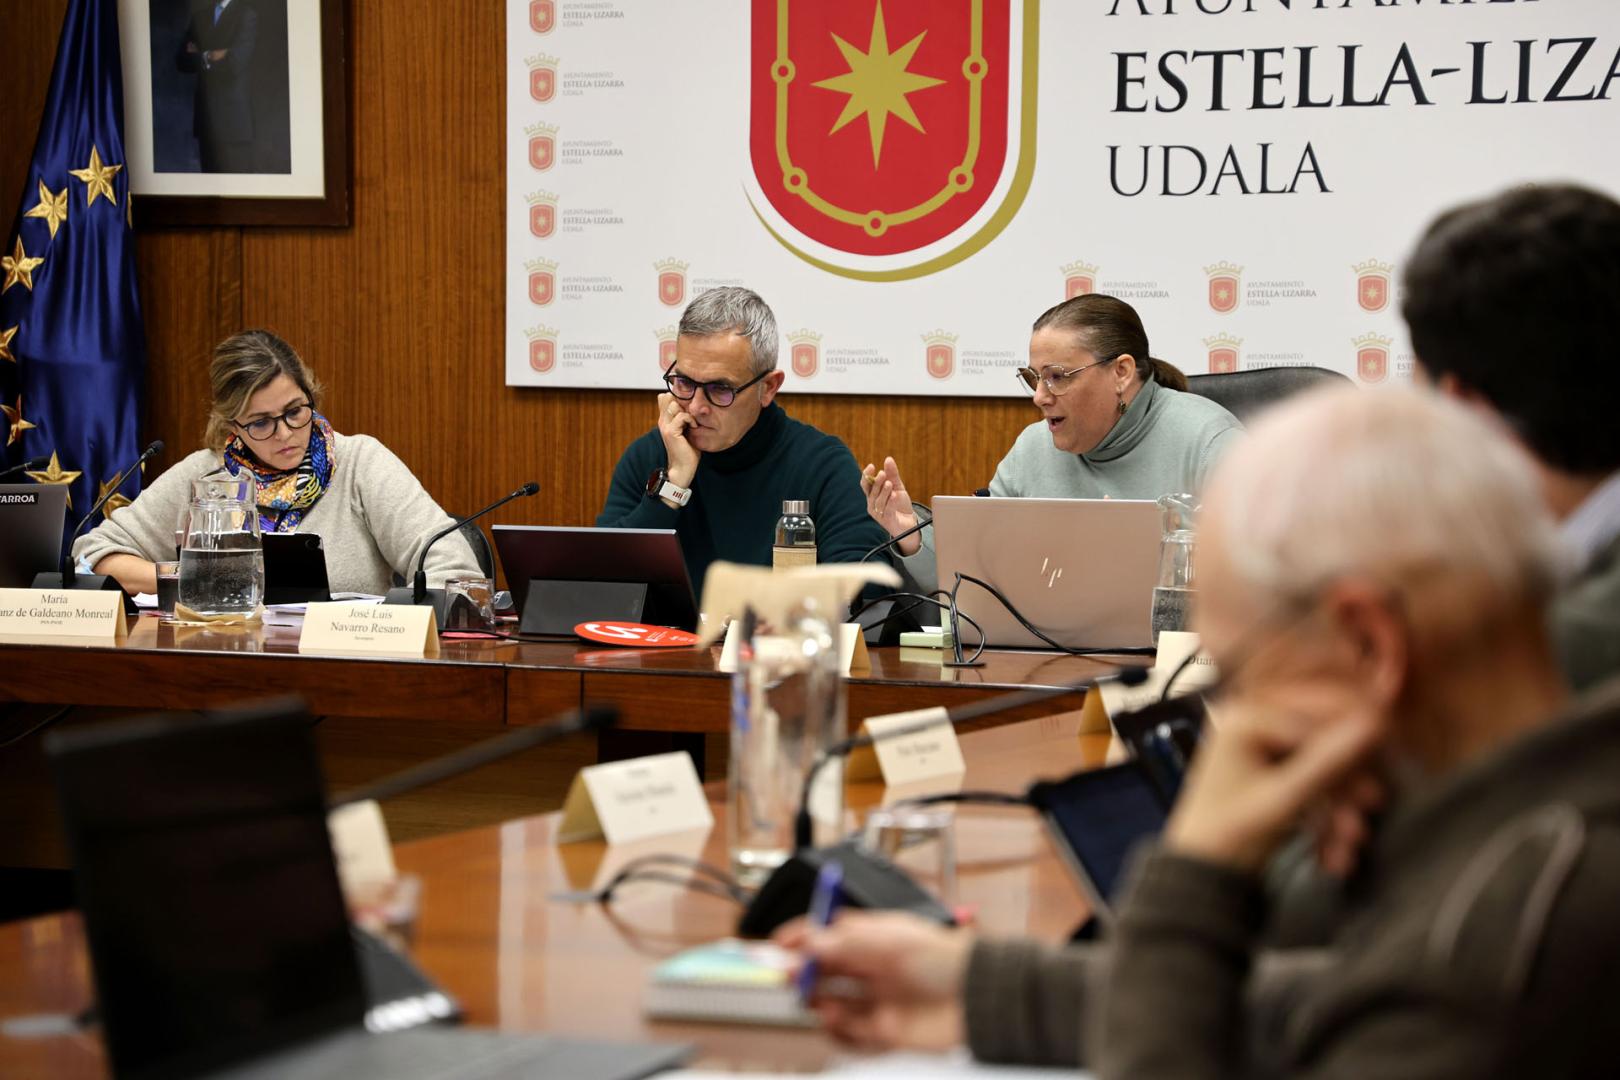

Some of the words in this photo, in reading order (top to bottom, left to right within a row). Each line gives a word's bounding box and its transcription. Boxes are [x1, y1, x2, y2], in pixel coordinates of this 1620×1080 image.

[1105, 141, 1333, 197] UDALA
[41, 594, 68, 604] María
[16, 607, 27, 617] de
[29, 608, 73, 618] Galdeano
[75, 609, 113, 619] Monreal
[348, 608, 369, 618] José
[371, 609, 393, 619] Luis
[330, 622, 369, 632] Navarro
[370, 624, 405, 634] Resano
